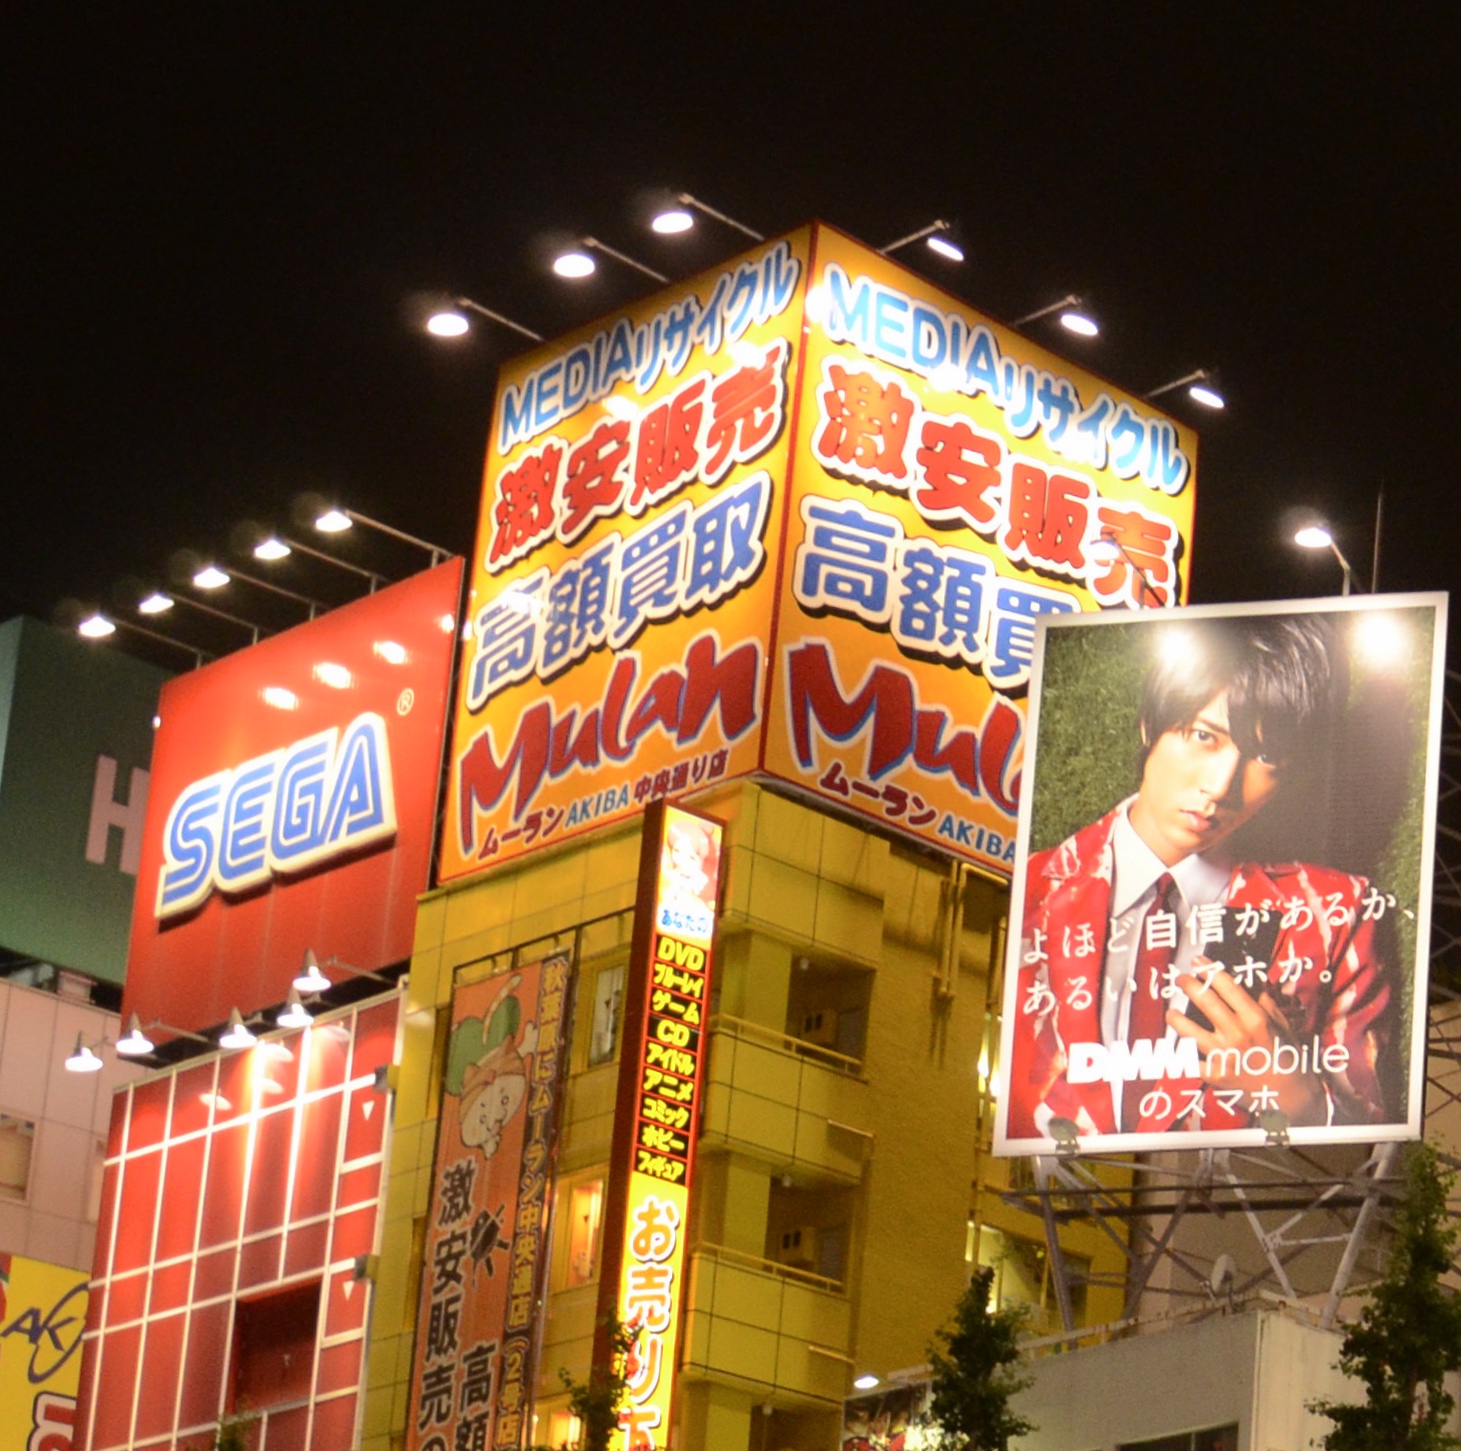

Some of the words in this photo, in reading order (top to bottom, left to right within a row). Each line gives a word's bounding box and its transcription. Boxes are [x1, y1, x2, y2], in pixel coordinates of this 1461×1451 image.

[490, 344, 784, 566] 激安販売
[816, 362, 1174, 608] 激安販売
[472, 480, 766, 703] 高額買取
[460, 635, 758, 855] Mulan
[154, 711, 398, 920] SEGA
[477, 806, 564, 862] ムーラン
[565, 787, 630, 827] AKIBA
[820, 766, 937, 825] ムーラン
[937, 820, 1018, 864] AKIBA
[656, 937, 706, 972] DVD
[653, 963, 704, 999] ブルーレイ
[651, 989, 700, 1026] ゲーム
[655, 1018, 690, 1048] CD
[645, 1041, 695, 1077] アイドル
[1067, 1036, 1202, 1085] DMM
[1205, 1039, 1351, 1079] mobile
[643, 1068, 694, 1103] アニメ
[1138, 1084, 1281, 1122] のスマホ
[642, 1096, 690, 1129] コミック
[641, 1123, 686, 1153] ホビー
[637, 1150, 686, 1182] フィギュア
